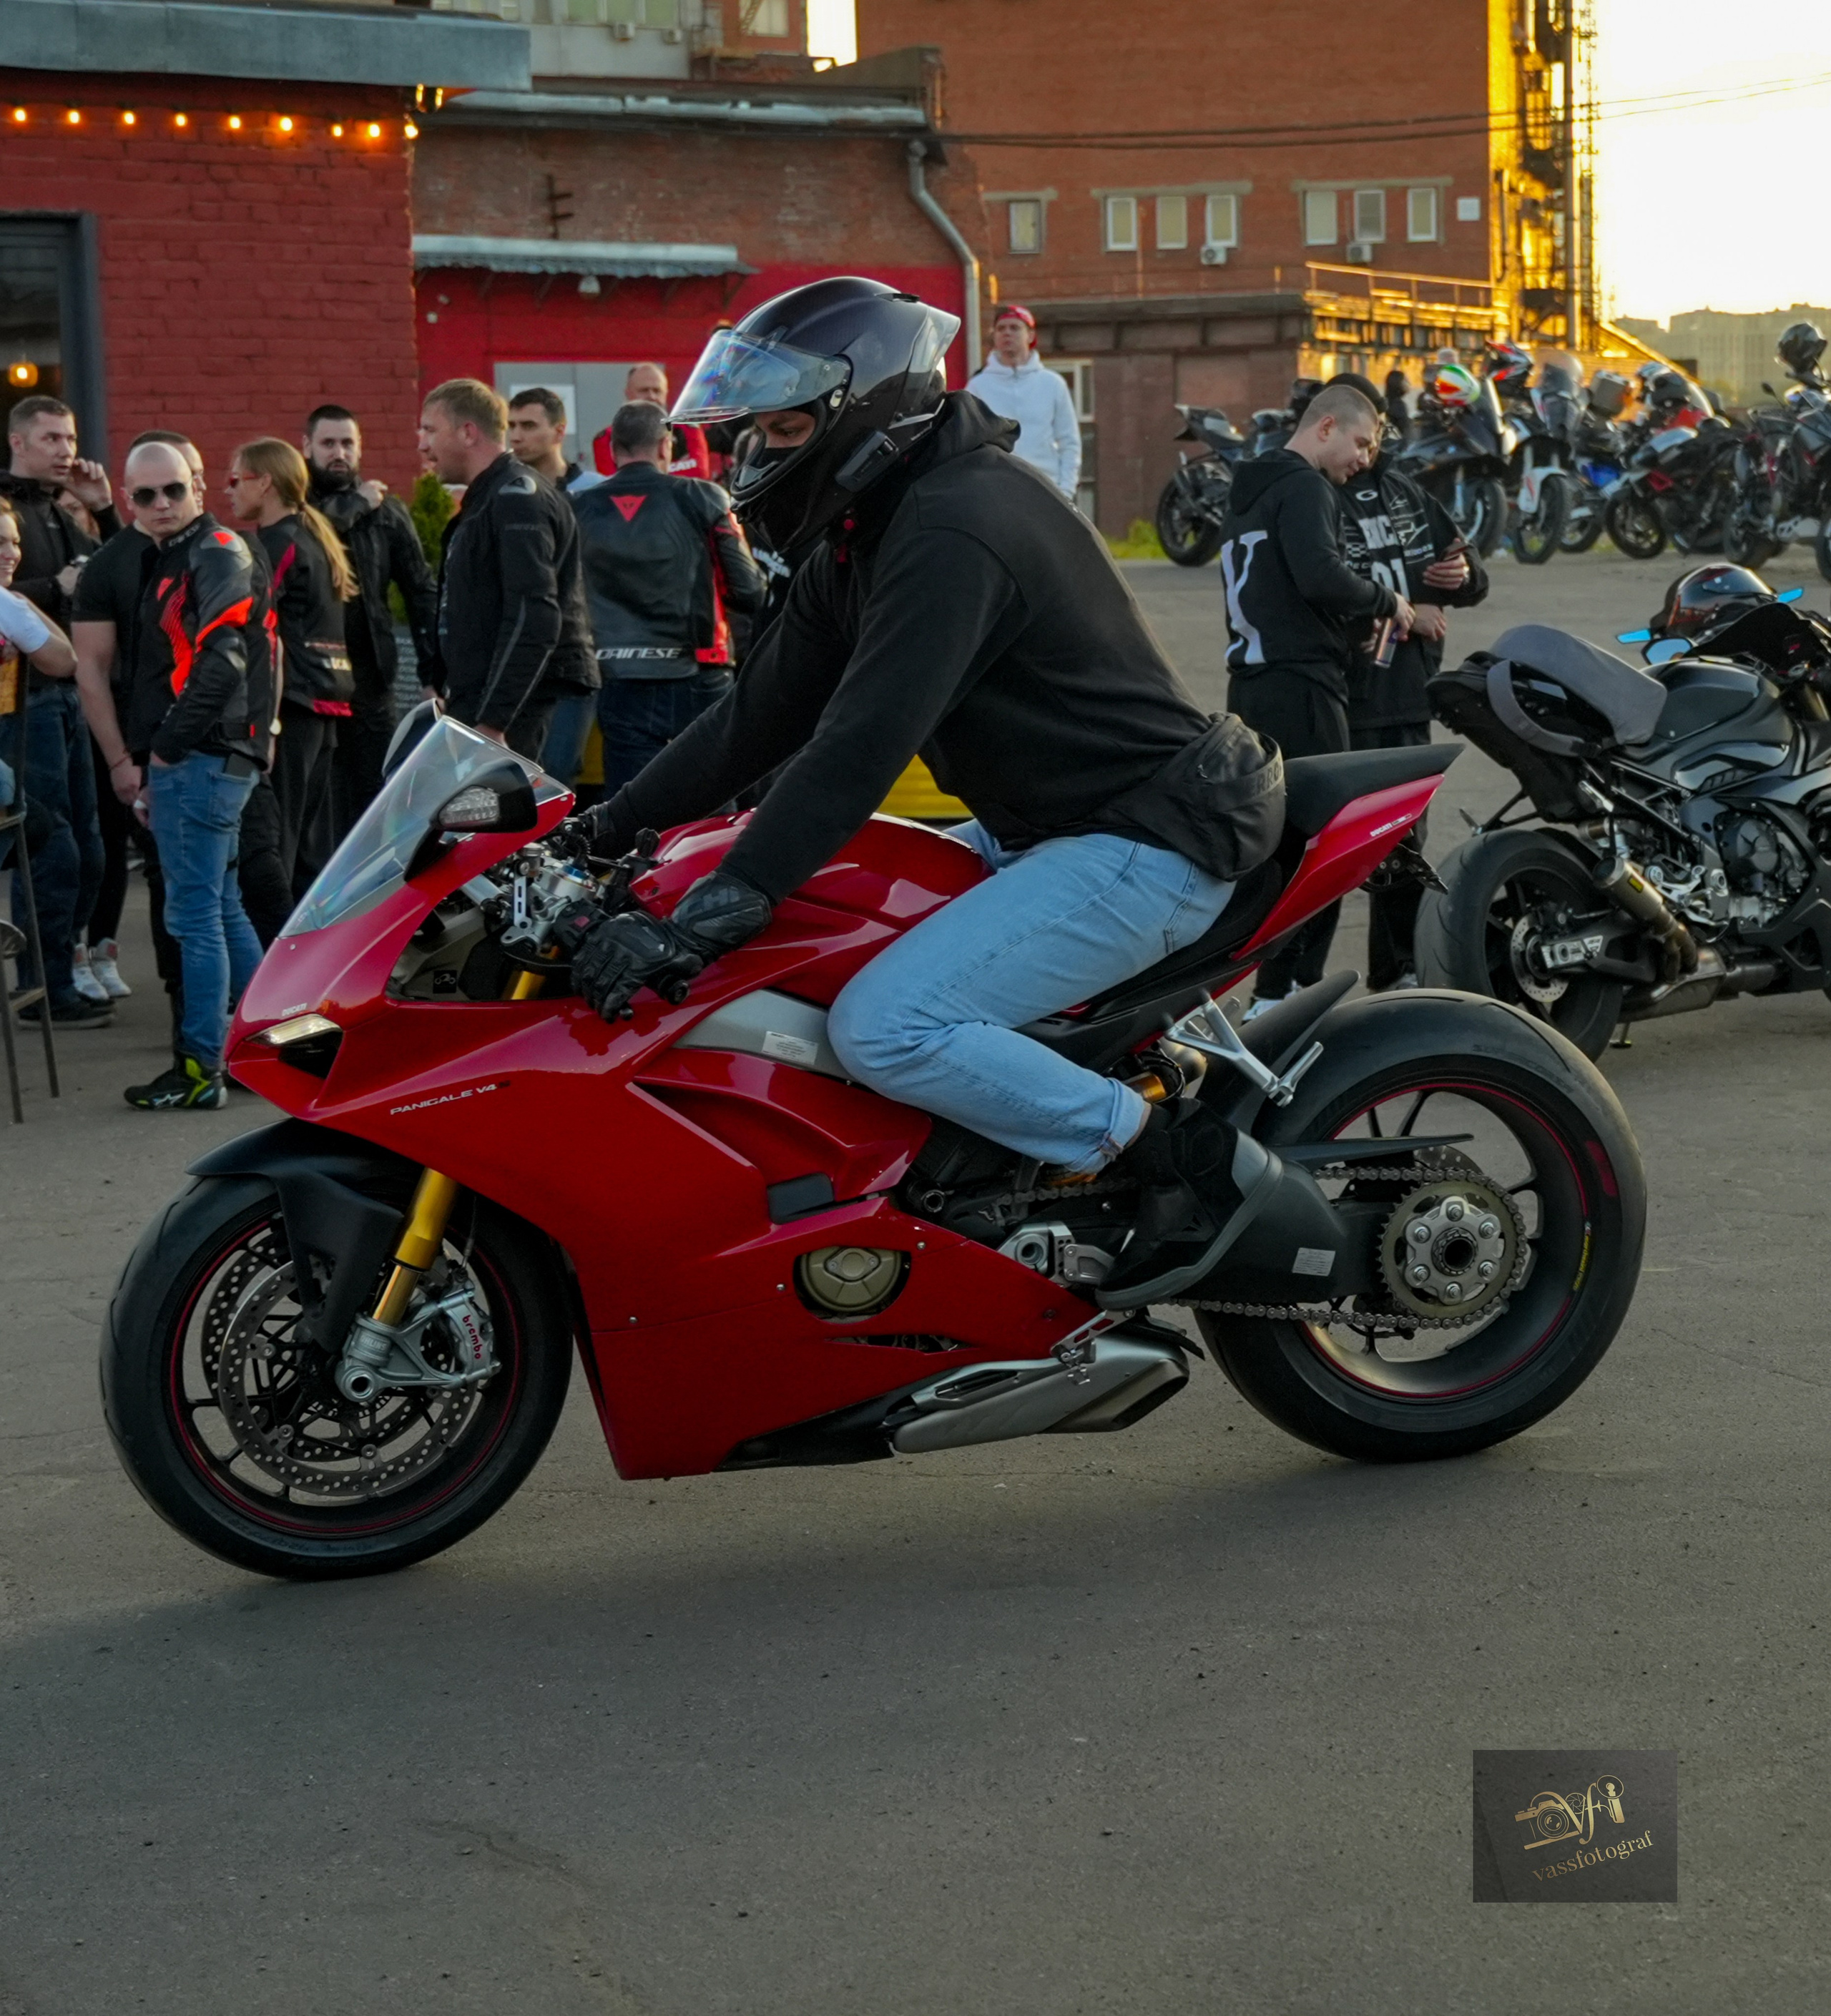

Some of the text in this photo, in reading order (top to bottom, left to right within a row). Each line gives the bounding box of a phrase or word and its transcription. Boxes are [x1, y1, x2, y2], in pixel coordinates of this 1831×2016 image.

[595, 647, 682, 660] DAINESE
[390, 1089, 473, 1116] PANIGALE
[476, 1083, 498, 1093] V4
[462, 1314, 483, 1359] brembo
